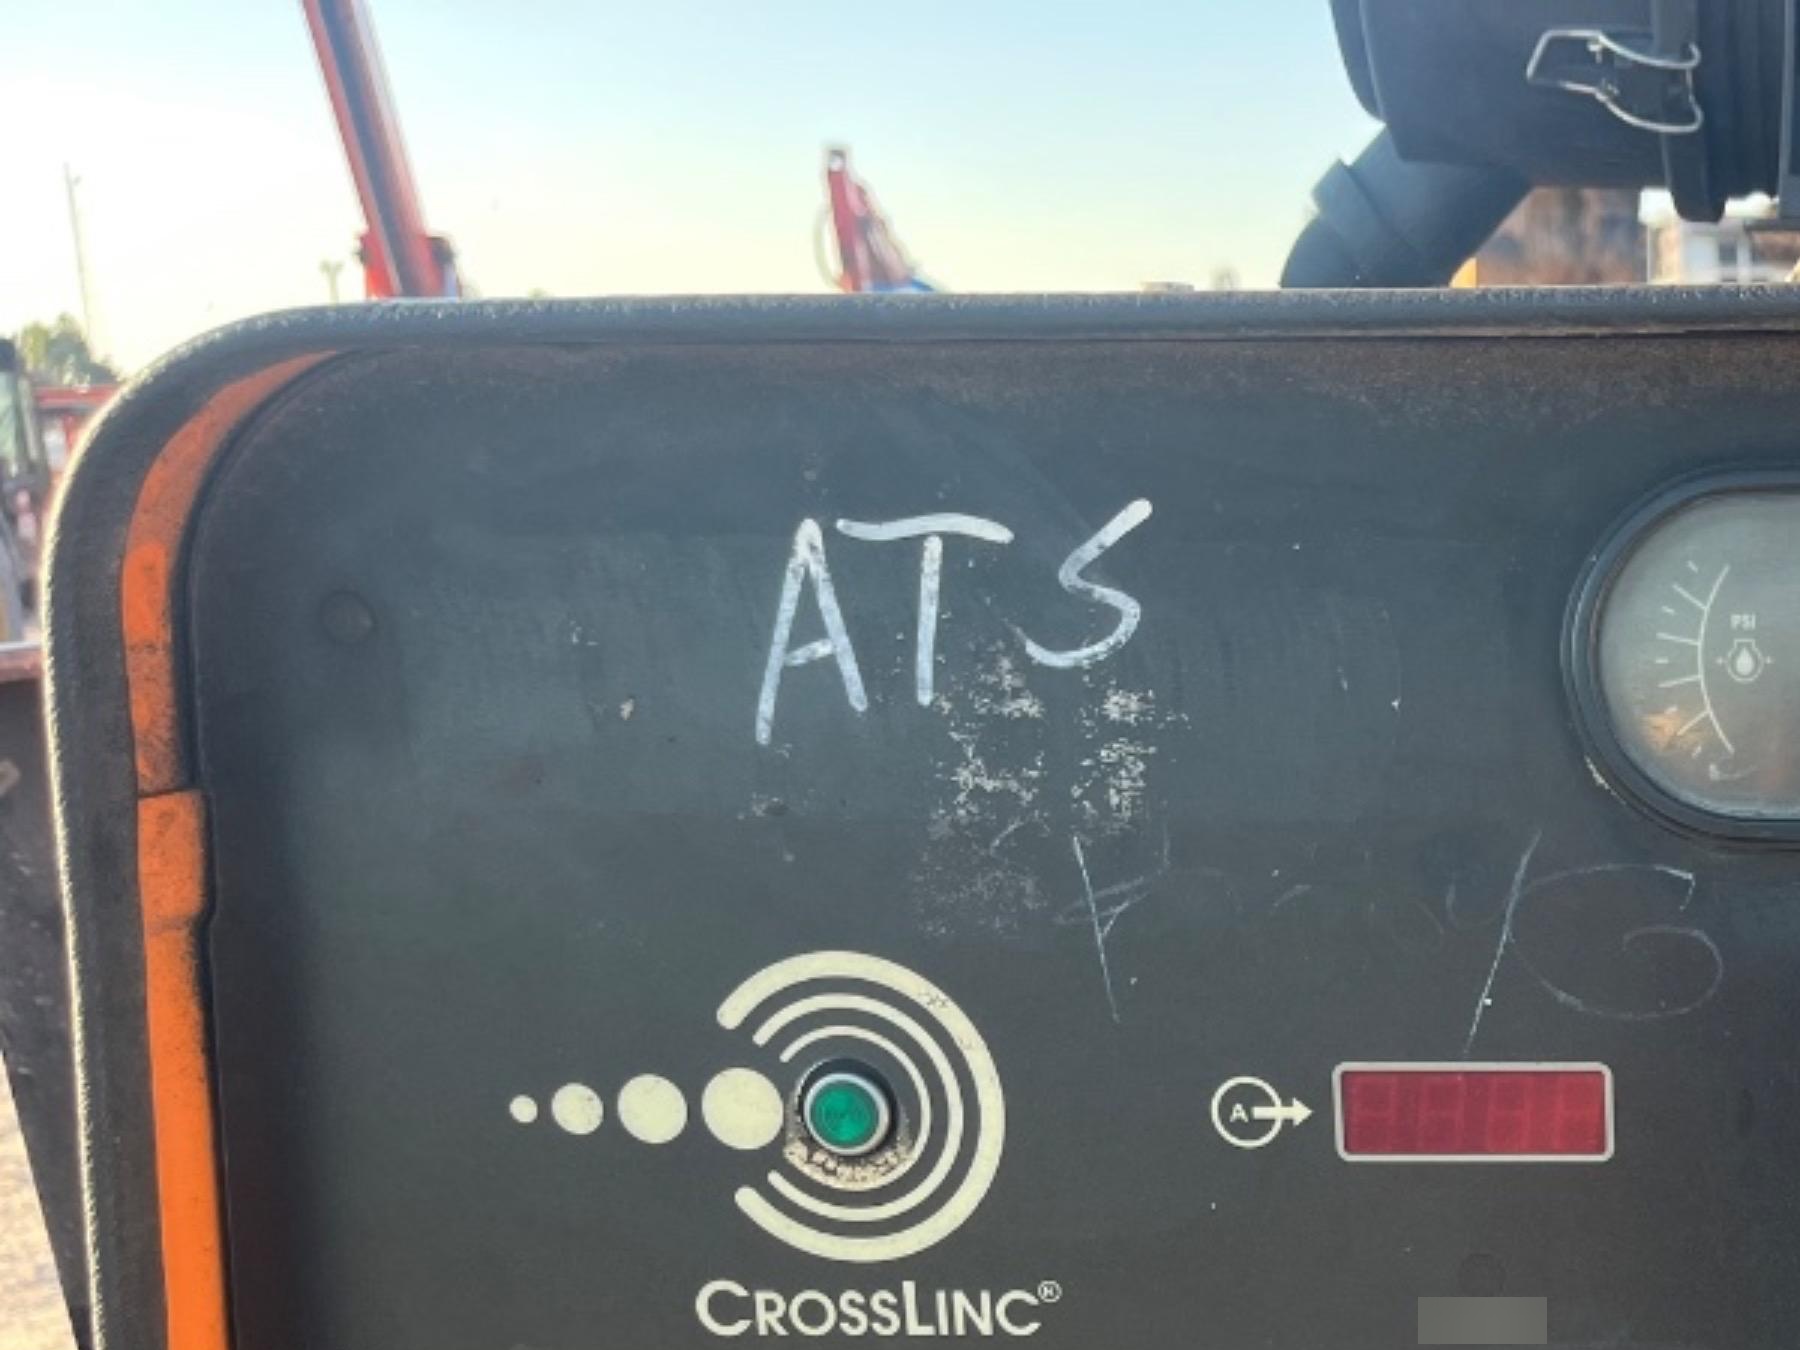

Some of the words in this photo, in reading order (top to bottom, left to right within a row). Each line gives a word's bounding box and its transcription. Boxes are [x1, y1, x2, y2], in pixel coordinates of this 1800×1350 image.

[756, 498, 1153, 746] ATS
[1730, 613, 1756, 630] PSI
[1231, 1102, 1249, 1123] A
